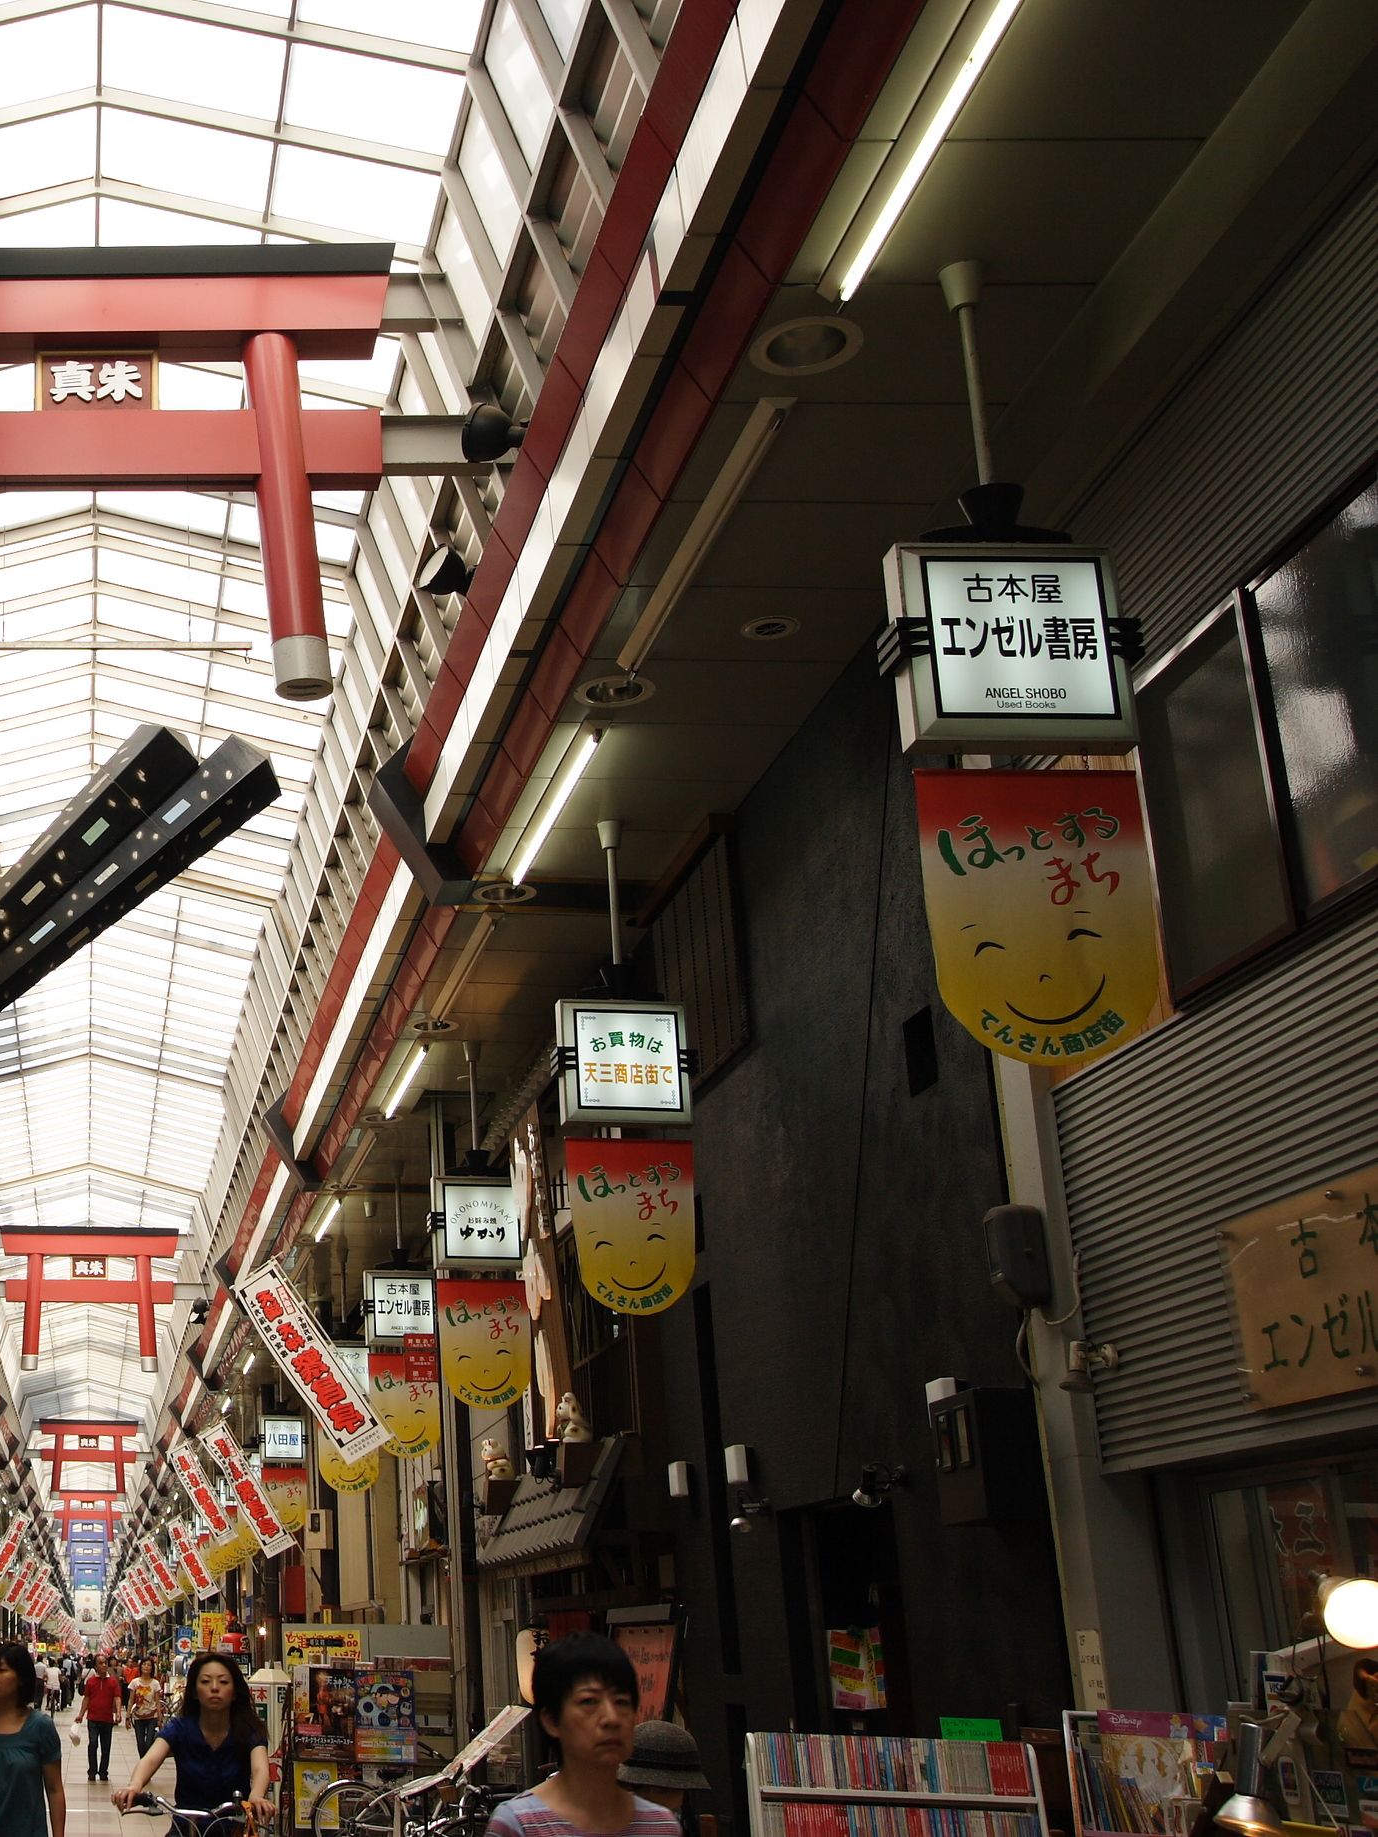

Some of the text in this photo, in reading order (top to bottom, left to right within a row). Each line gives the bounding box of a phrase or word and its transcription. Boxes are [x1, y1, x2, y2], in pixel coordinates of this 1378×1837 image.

[49, 360, 143, 404] 真朱
[963, 572, 1064, 605] 古本屋
[940, 616, 1098, 661] エンゼル書房
[985, 687, 1067, 699] ANGEL SHOBO
[997, 700, 1056, 709] Used Books
[937, 806, 1120, 877] ほっとする
[1044, 851, 1120, 906] まち
[589, 1030, 665, 1054] お買物は
[978, 1009, 1126, 1058] てんさん商店街
[584, 1061, 673, 1086] 天三商店街で
[578, 1161, 682, 1201] ほっとする
[450, 1200, 514, 1225] OKONOMIYAKI
[636, 1189, 679, 1221] まち
[387, 1283, 420, 1295] 古本屋
[594, 1280, 673, 1310] てんさん商店街
[378, 1299, 430, 1316] エンゼル書房
[445, 1296, 520, 1327] ほっとする
[488, 1316, 520, 1340] まち
[409, 1383, 433, 1402] まち
[267, 1433, 300, 1446] 八田屋
[1106, 1712, 1143, 1728] Disney
